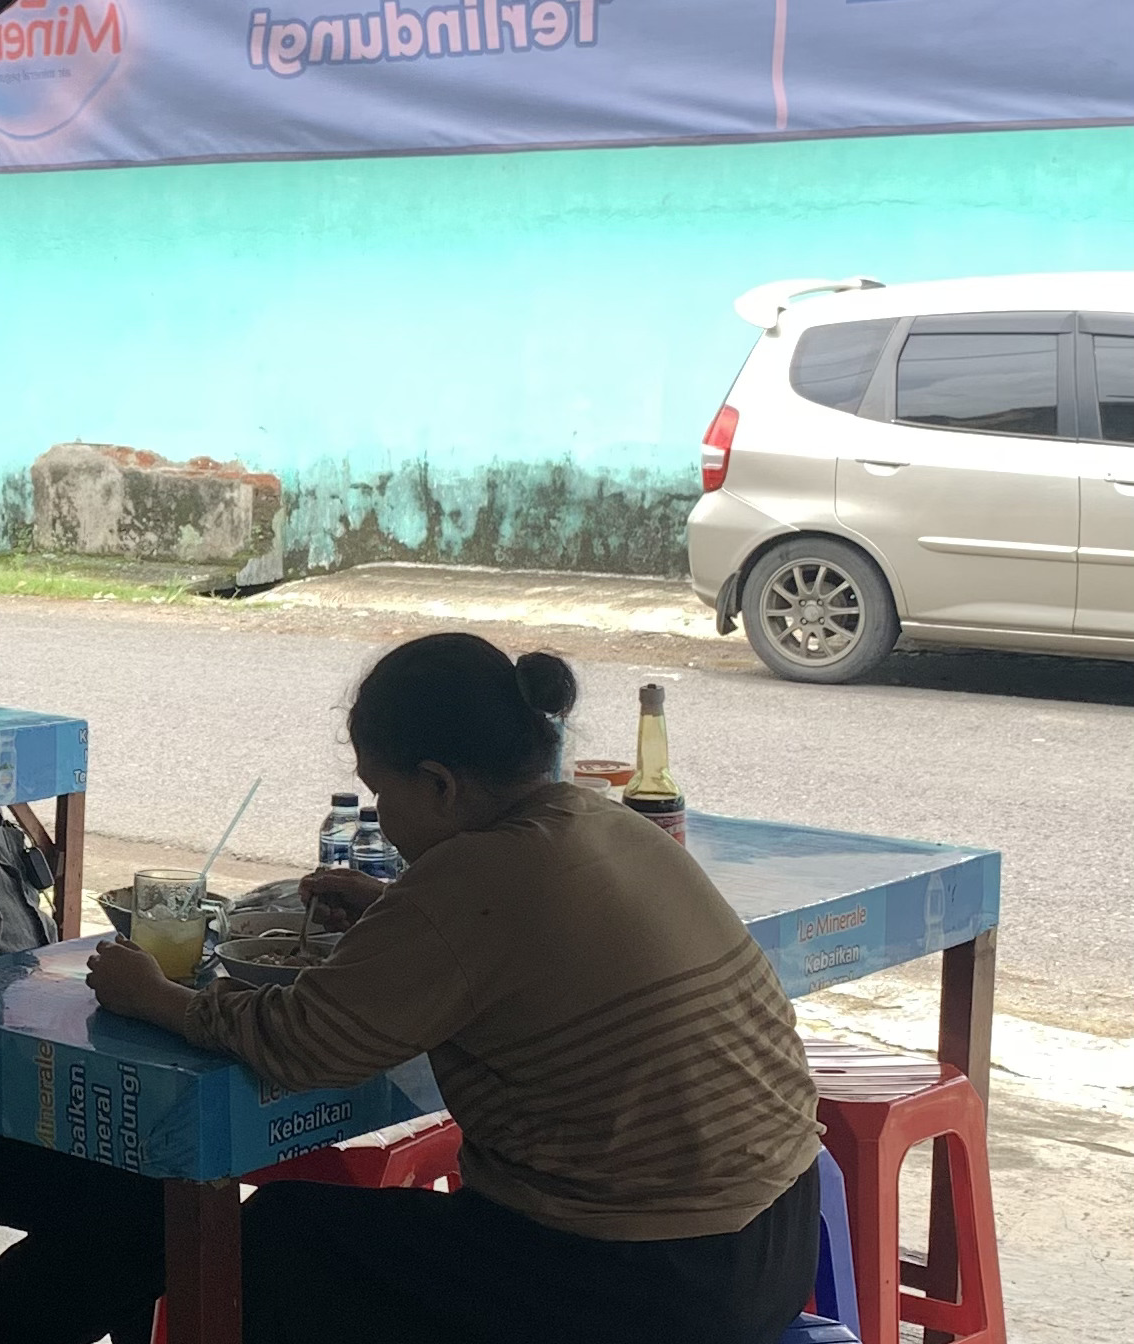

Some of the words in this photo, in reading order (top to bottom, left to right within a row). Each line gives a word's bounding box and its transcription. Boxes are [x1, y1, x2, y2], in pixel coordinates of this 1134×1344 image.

[798, 919, 815, 944] Le
[815, 904, 868, 937] Minerale
[804, 944, 860, 976] Kebaikan
[268, 1099, 353, 1148] Kebaikan
